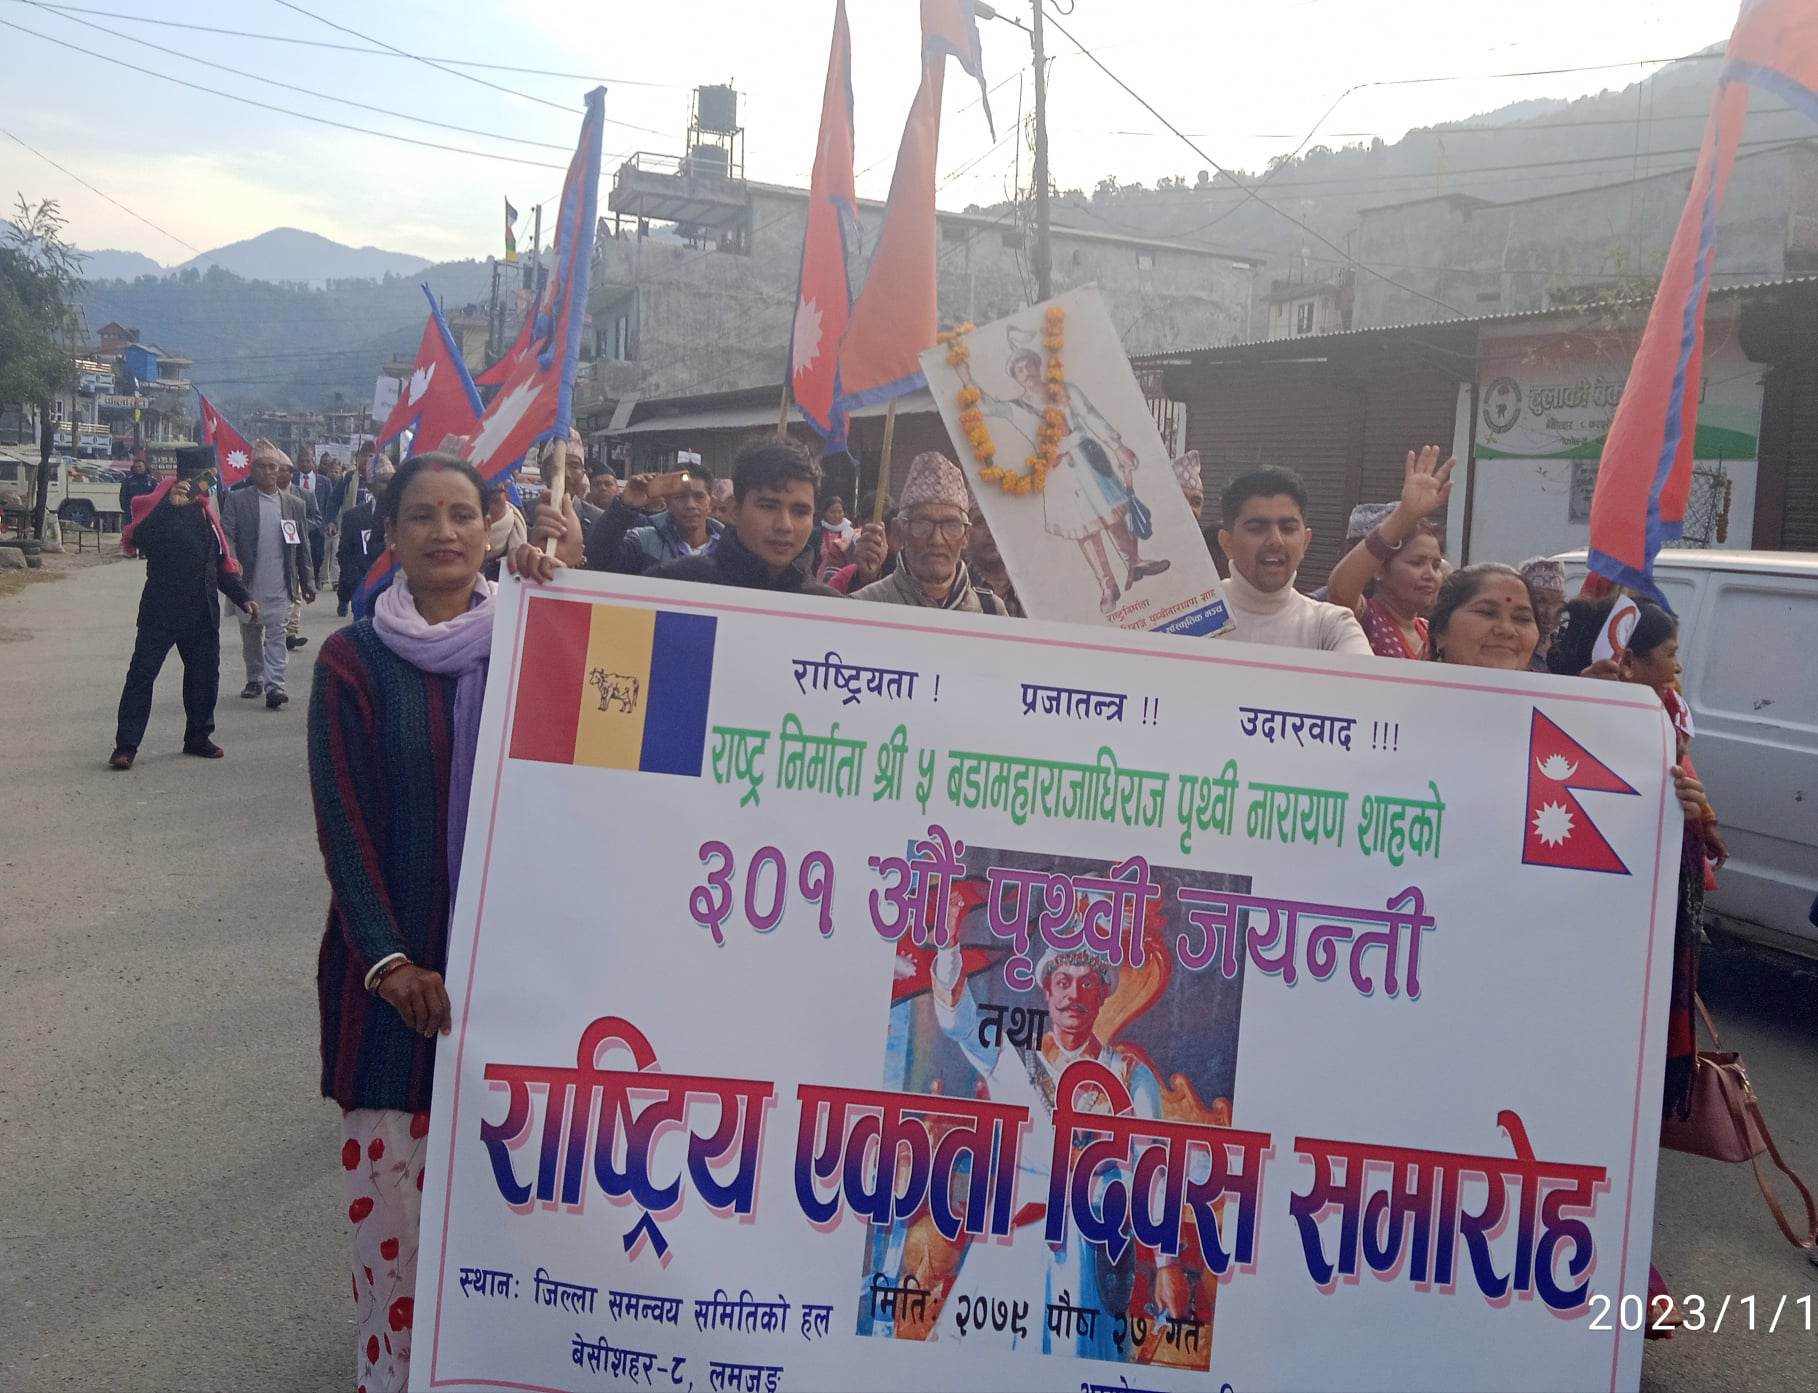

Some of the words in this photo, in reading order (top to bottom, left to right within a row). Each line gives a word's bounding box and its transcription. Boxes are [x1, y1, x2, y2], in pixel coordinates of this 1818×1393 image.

[792, 651, 919, 706] राष्ट्रियता
[1020, 683, 1128, 723] प्रजातन्त्र
[1239, 706, 1357, 752] उदारवाद
[711, 725, 771, 808] राष्ट्र
[776, 712, 867, 798] निर्माता
[873, 723, 909, 803] श्री
[915, 748, 936, 816] ५
[947, 745, 1170, 828] बडामहाराजाधिराज
[1177, 758, 1240, 855] पृथ्वी
[1246, 781, 1350, 848] नारायण
[1357, 780, 1446, 867] शाहको
[689, 840, 835, 946] ३०१
[867, 824, 967, 948] औं
[986, 855, 1161, 992] पृथ्वी
[1176, 885, 1437, 999] जयन्ती
[977, 1002, 1050, 1052] तथा
[479, 1015, 777, 1262] राष्ट्रिय
[794, 1082, 1032, 1243] एकता
[1044, 1059, 1273, 1278] दिवस
[1290, 1109, 1609, 1312] समारोह
[534, 1267, 598, 1315] जिल्ला
[608, 1290, 684, 1326] समन्वय
[694, 1288, 791, 1334] समितिको
[801, 1303, 834, 1342] हल
[955, 1294, 1029, 1340] २०७९
[1046, 1288, 1100, 1343] पौष
[1112, 1311, 1148, 1354] २७
